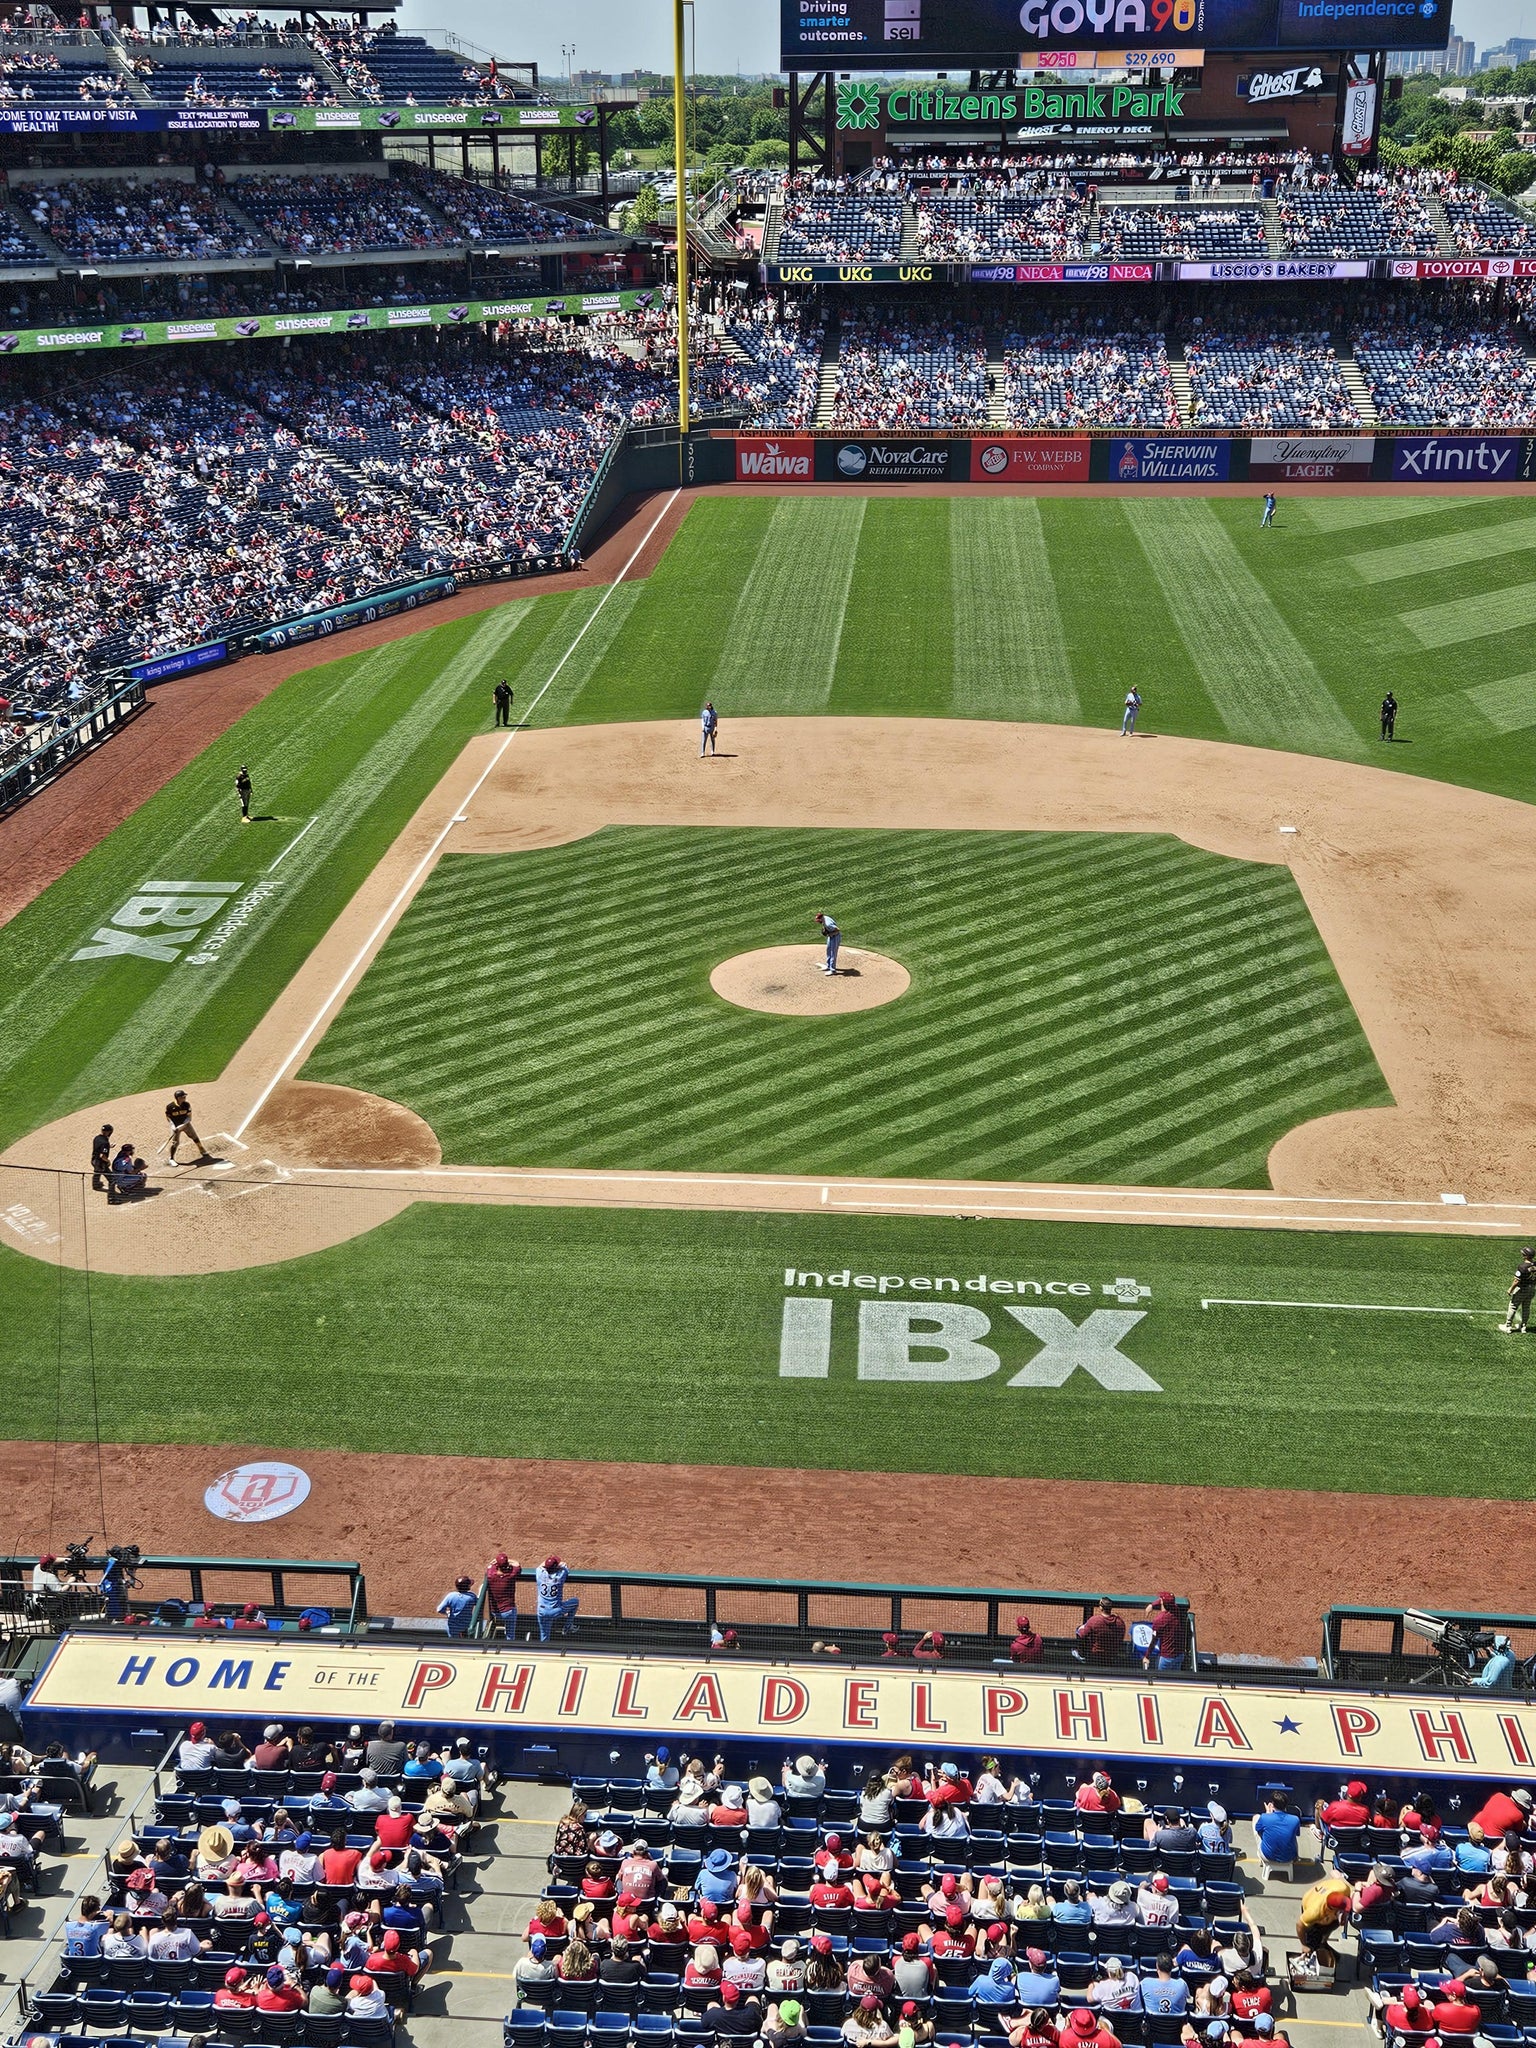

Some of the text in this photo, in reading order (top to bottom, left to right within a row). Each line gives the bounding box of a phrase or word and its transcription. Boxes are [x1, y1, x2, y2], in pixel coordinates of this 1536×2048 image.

[799, 1, 847, 14] Driving
[1298, 0, 1416, 20] Independence
[799, 16, 851, 27] smarter
[1019, 0, 1196, 38] GOYA 90
[1197, 0, 1205, 32] EARS
[799, 29, 868, 41] outcomes.
[1125, 52, 1176, 67] $29,690
[1248, 67, 1310, 103] GHOST
[887, 83, 1185, 121] Citizens Bank Park
[28, 111, 43, 121] TO
[62, 111, 91, 121] TEAM
[93, 110, 107, 120] OF
[108, 110, 138, 120] VISTA
[230, 111, 249, 119] WITH
[12, 122, 59, 132] WEALTH!
[1076, 126, 1121, 135] ENERGY
[1123, 126, 1153, 134] DECK
[779, 266, 813, 281] UKG
[839, 266, 873, 281] UKG
[899, 266, 932, 281] UKG
[1020, 267, 1061, 279] NECA
[1112, 266, 1153, 279] NECA
[1211, 263, 1336, 277] LISCIO'S BAKERY
[1422, 262, 1482, 274] TOYOTA
[738, 430, 795, 438] ASPLUNDH
[806, 430, 865, 438] ASPLUNDH
[875, 430, 934, 438] ASPLUNDH
[946, 430, 1004, 438] ASPLUNDH
[1016, 430, 1075, 438] ASPLUNDH
[1086, 430, 1145, 438] ASPLUNDH
[1156, 430, 1216, 438] ASPLUNDH
[1229, 429, 1288, 437] ASPLUNDH
[1300, 429, 1360, 437] ASPLUNDH
[1372, 429, 1434, 437] ASPLUNDH
[868, 446, 948, 465] NovaCare
[1013, 451, 1036, 463] F.W.
[1041, 451, 1082, 463] WEBB
[1143, 443, 1218, 459] SHERWIN
[1273, 441, 1352, 463] Yuengling
[1400, 440, 1511, 475] xfinity
[741, 452, 809, 475] Wawa
[868, 467, 945, 475] REHABILITATION
[1285, 465, 1334, 477] LAGER
[69, 880, 245, 963] IBX
[202, 881, 284, 951] Independence
[783, 1268, 1092, 1295] Independence
[779, 1296, 1164, 1392] IBX
[540, 1583, 558, 1598] 38
[117, 1654, 292, 1691] HOME
[314, 1670, 339, 1684] OF
[347, 1672, 380, 1686] THE
[401, 1659, 1253, 1751] PHILADELPHIA
[1158, 1998, 1171, 2014] 3
